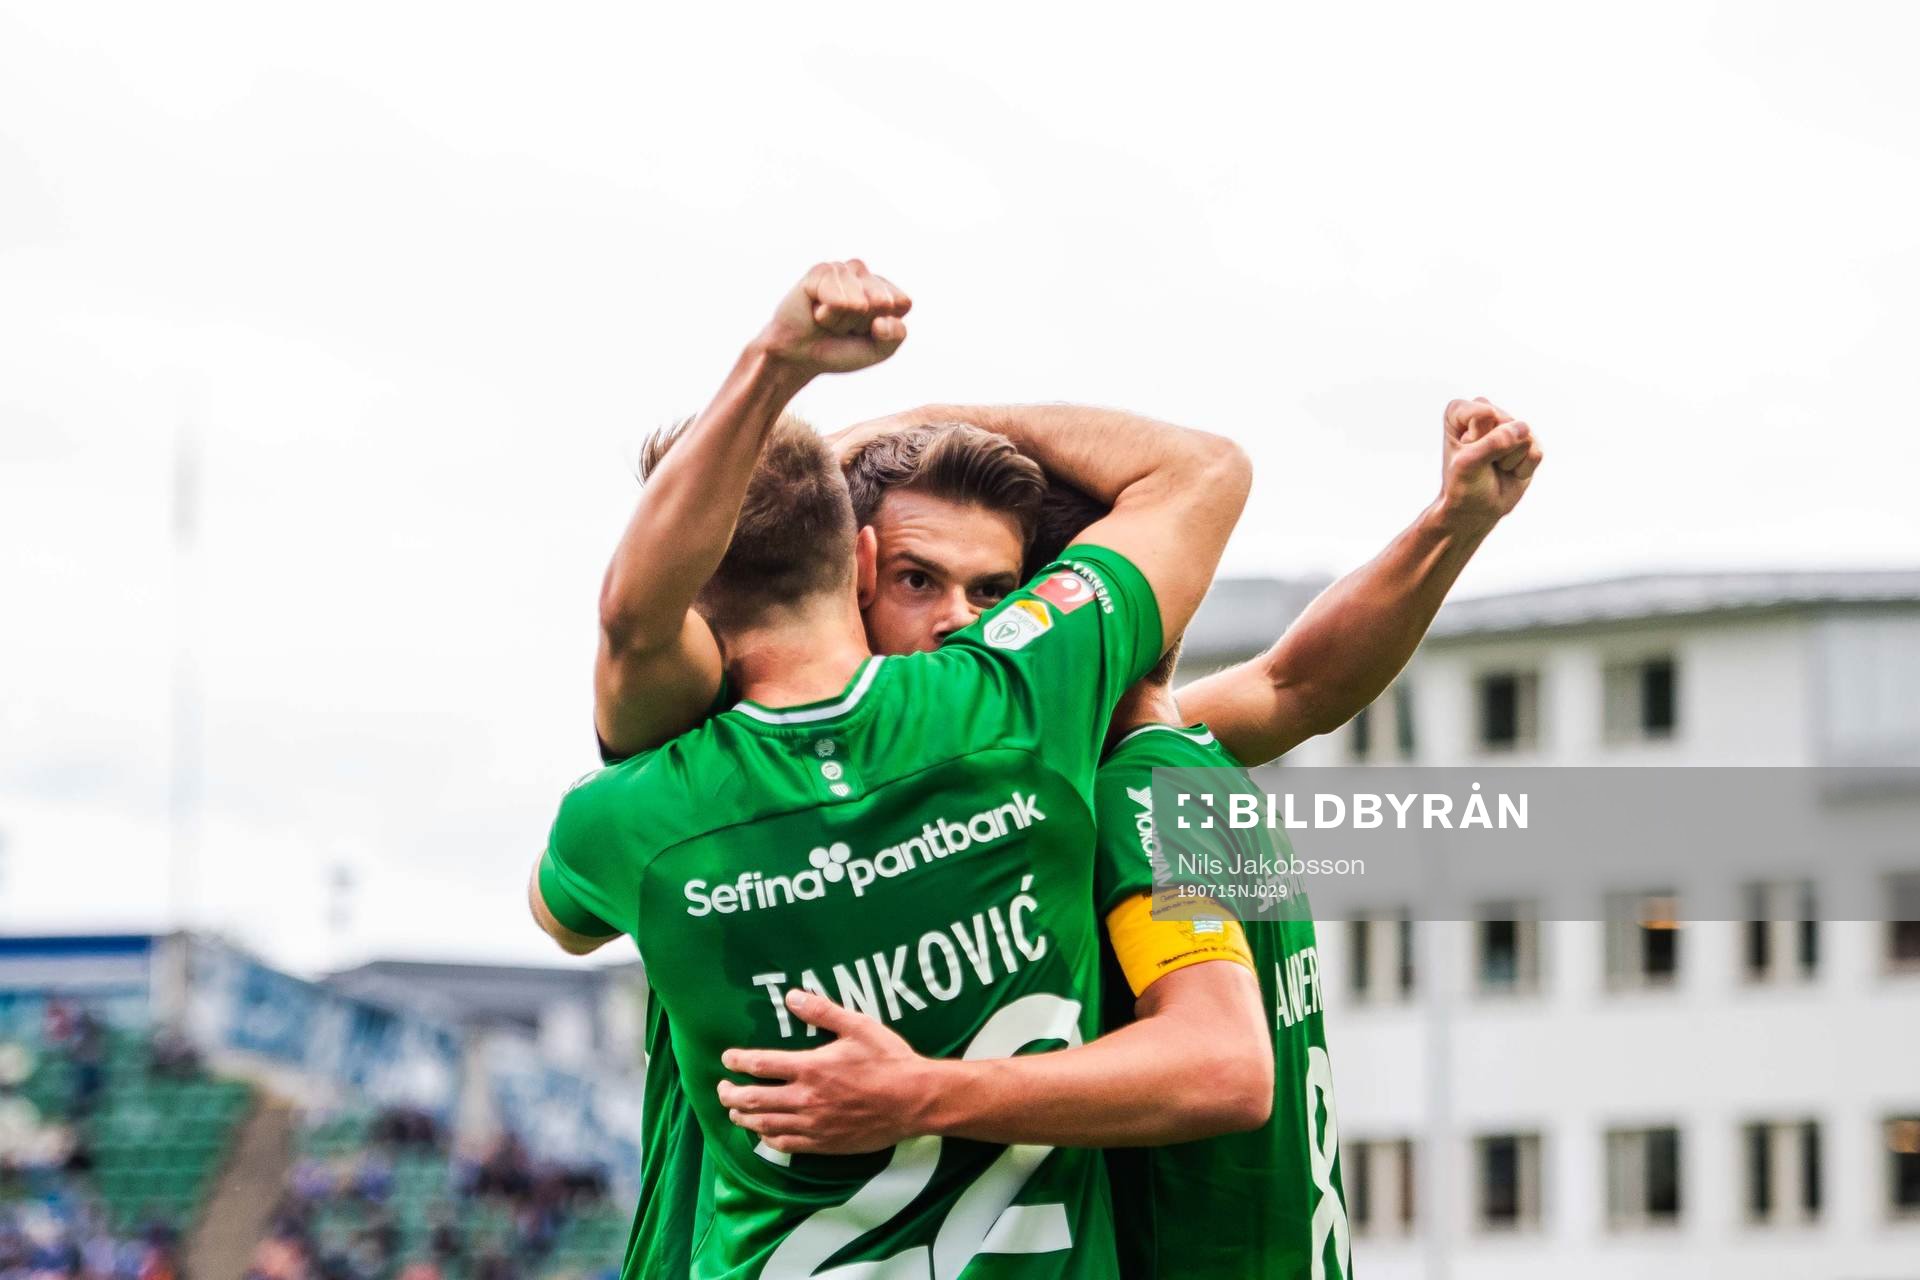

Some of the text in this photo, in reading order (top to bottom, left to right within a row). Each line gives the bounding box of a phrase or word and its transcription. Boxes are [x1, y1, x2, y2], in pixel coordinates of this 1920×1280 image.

[1072, 561, 1115, 615] SVENSKA
[682, 791, 1047, 918] Sefina pantbank
[1134, 810, 1176, 888] YOKOHAM
[752, 873, 1048, 1039] TANKOVIĆ
